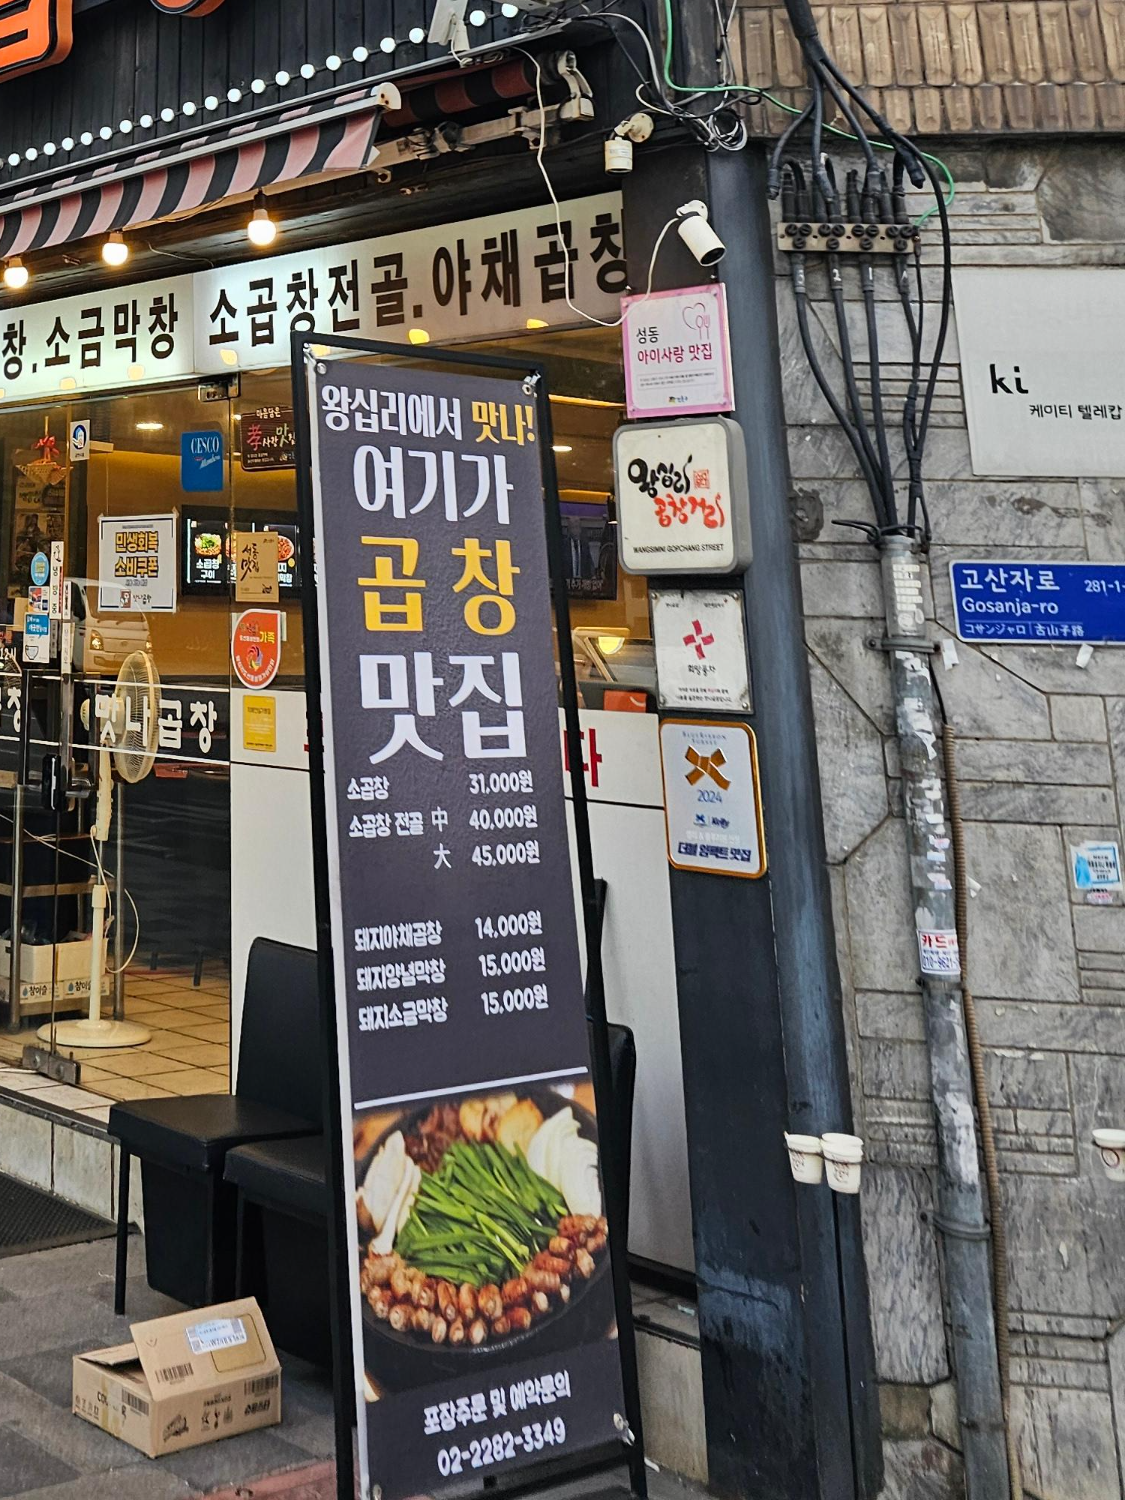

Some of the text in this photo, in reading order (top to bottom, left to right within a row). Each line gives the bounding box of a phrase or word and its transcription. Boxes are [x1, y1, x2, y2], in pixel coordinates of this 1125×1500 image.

[636, 326, 659, 344] 성동
[637, 342, 712, 364] 아이사랑 맛집
[321, 384, 536, 445] 왕십리에서 맛나!
[1029, 404, 1122, 420] 케이티 텔레캅
[191, 436, 219, 454] CESCO
[353, 445, 514, 524] 여기가
[628, 454, 692, 498] 왕십리
[115, 531, 159, 553] 민생회복
[701, 543, 724, 551] STREET
[115, 556, 159, 578] 소비쿠폰
[960, 567, 1060, 593] 고산자로
[962, 597, 1059, 616] Gosanja-ro
[965, 624, 1026, 636] コサンジャロ
[359, 651, 527, 764] 맛집
[95, 693, 217, 753] 맛나곱창
[347, 775, 389, 800] 소곱창
[697, 789, 723, 804] 2024
[349, 812, 391, 838] 소곱창
[394, 811, 424, 836] 전골
[431, 806, 448, 832] 中
[433, 843, 451, 869] 大
[354, 920, 443, 952] 돼지야채곱창
[922, 934, 947, 948] 카드
[356, 958, 446, 991] 돼지양념막창
[29, 985, 47, 996] 참이슬
[358, 997, 448, 1031] 돼지소금막창
[423, 1368, 572, 1436] 포장주문 및 예약문의
[437, 1416, 566, 1477] 02-2282-3349
